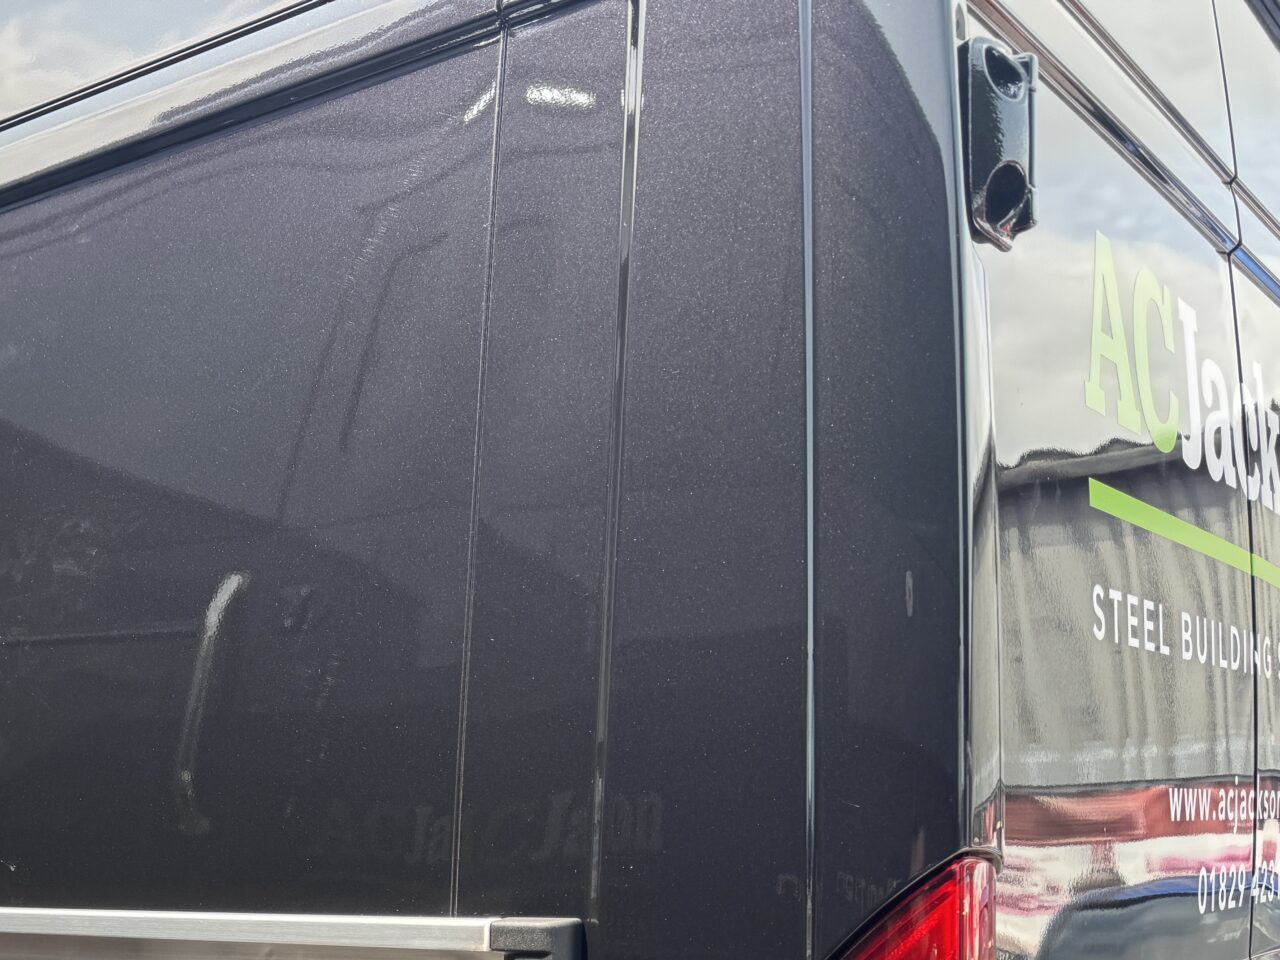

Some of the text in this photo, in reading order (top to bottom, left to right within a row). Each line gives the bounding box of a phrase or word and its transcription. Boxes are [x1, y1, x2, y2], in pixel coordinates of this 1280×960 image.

[1092, 583, 1171, 656] STEEL
[1181, 611, 1272, 680] BUILDING
[1198, 862, 1246, 915] 01829
